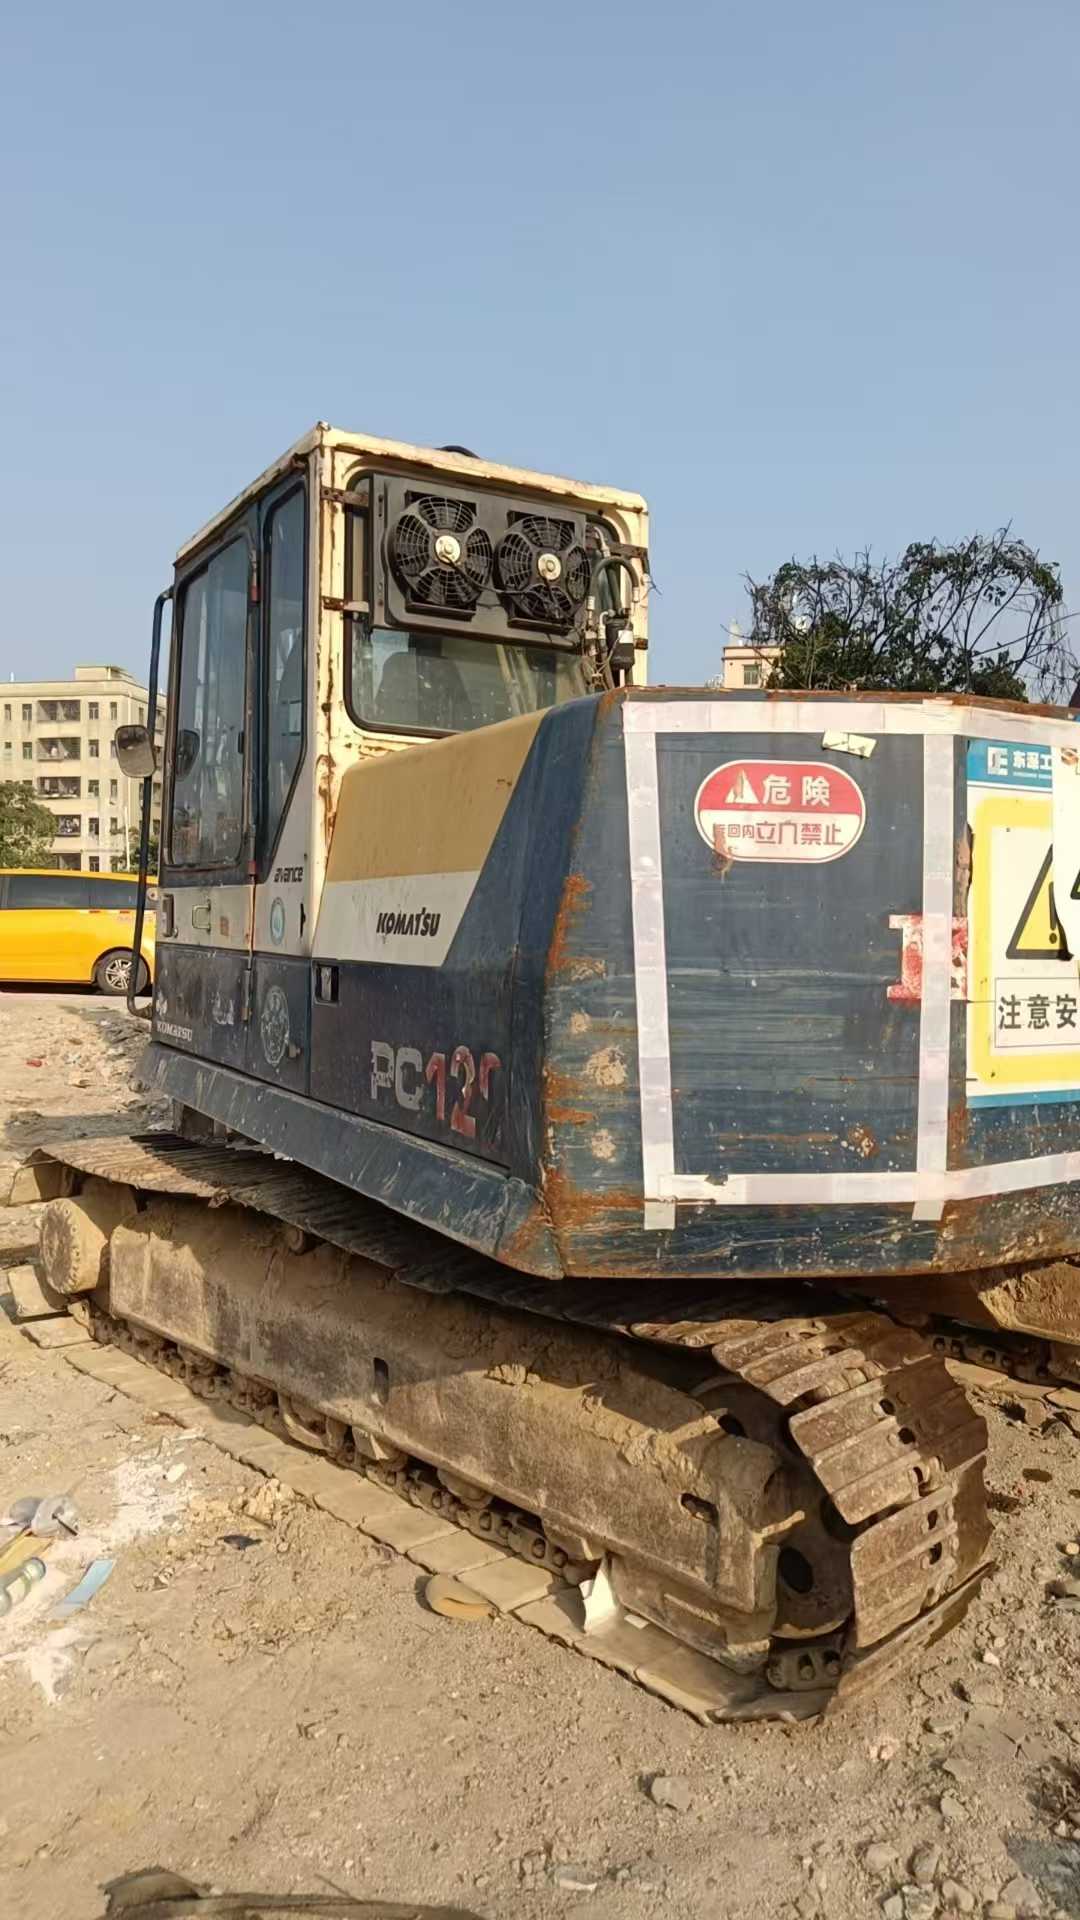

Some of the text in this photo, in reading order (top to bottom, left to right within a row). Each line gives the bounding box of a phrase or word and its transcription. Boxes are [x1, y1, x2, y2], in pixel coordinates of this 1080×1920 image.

[375, 906, 442, 937] KOMATSU
[998, 993, 1078, 1030] 注意安
